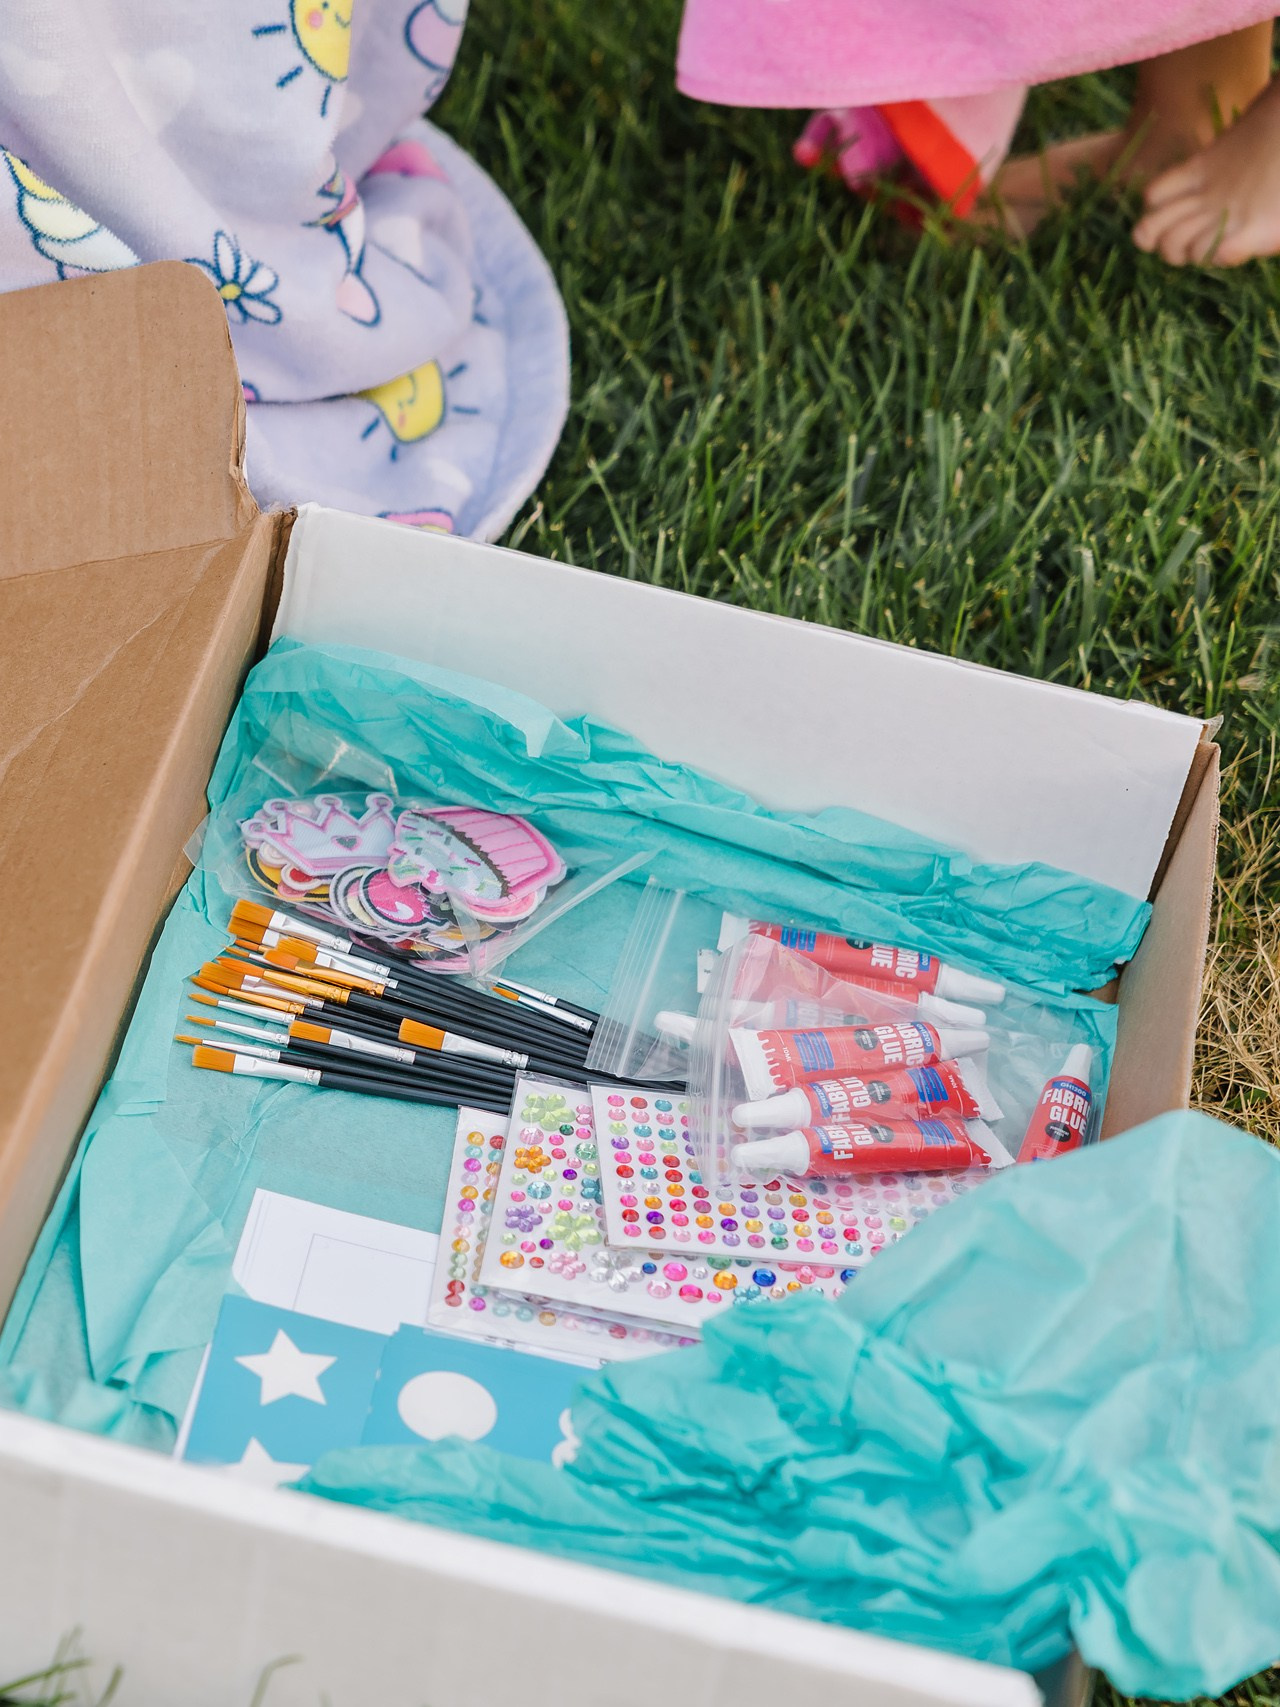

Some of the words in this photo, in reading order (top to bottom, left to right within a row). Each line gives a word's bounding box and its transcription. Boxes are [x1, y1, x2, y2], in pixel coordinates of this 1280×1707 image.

[870, 942, 894, 969] LUE
[895, 947, 919, 979] BRIC
[873, 1025, 903, 1065] GLUE
[892, 1022, 925, 1066] ABRIC
[816, 1078, 851, 1123] FABRI
[838, 1076, 872, 1108] GLU
[1060, 1082, 1087, 1097] GH1200
[843, 1123, 875, 1146] GLU
